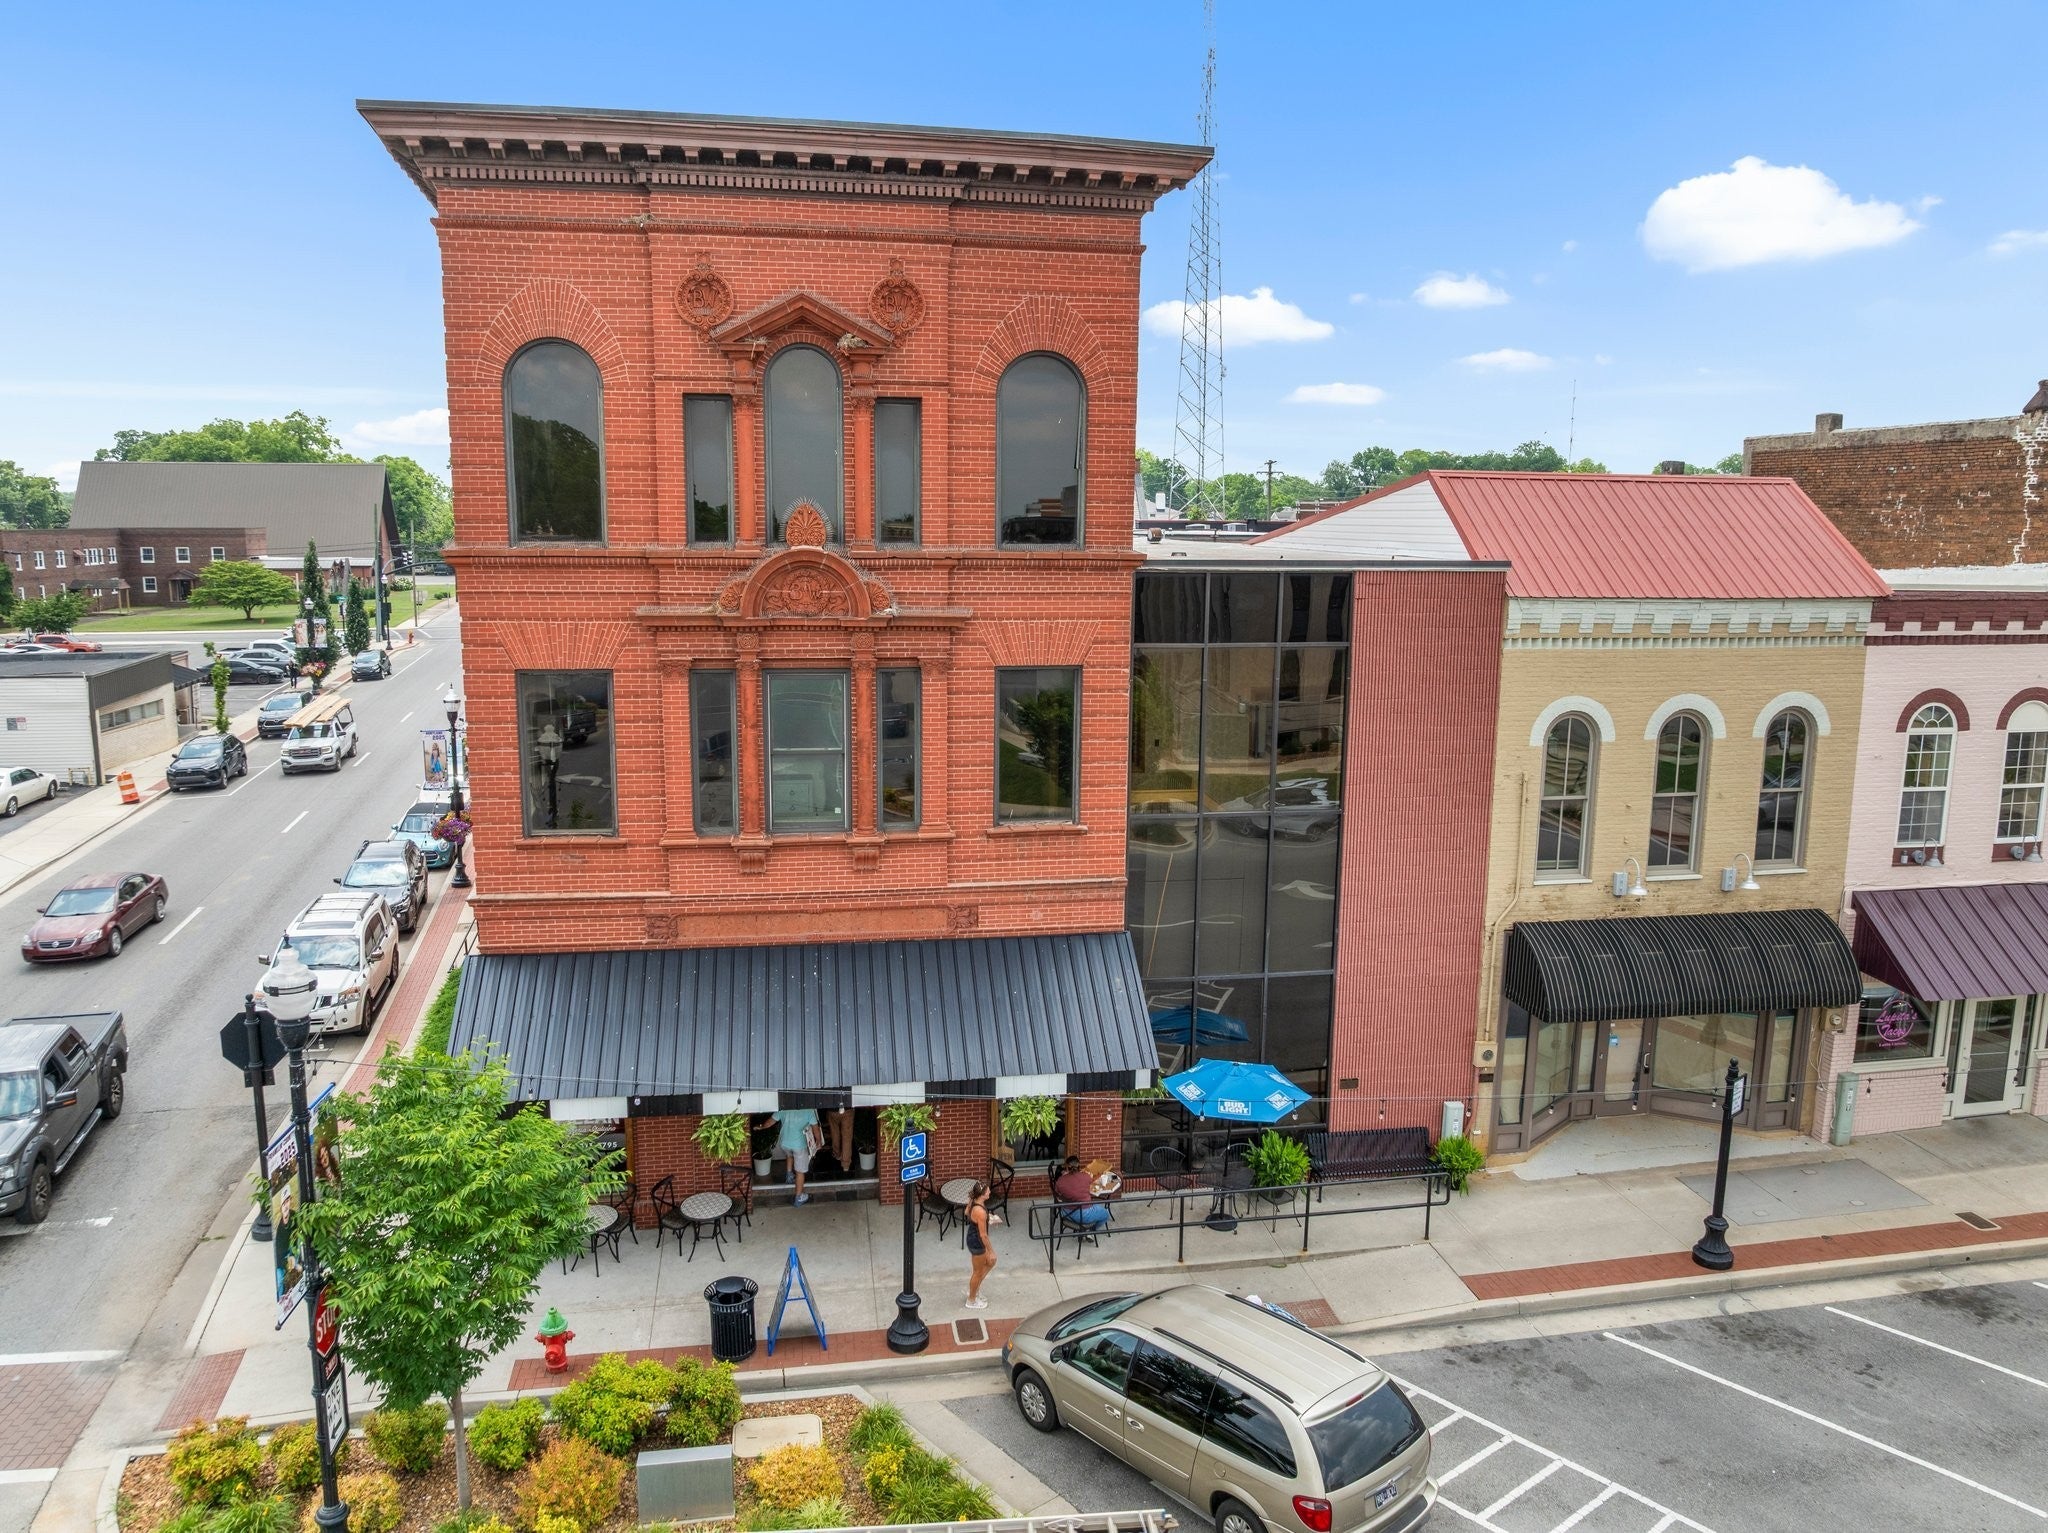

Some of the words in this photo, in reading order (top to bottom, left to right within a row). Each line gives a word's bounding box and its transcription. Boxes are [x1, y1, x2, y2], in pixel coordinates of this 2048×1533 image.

[1220, 1106, 1249, 1114] LIGHT
[316, 1305, 336, 1343] STO
[327, 1379, 341, 1410] ONE
